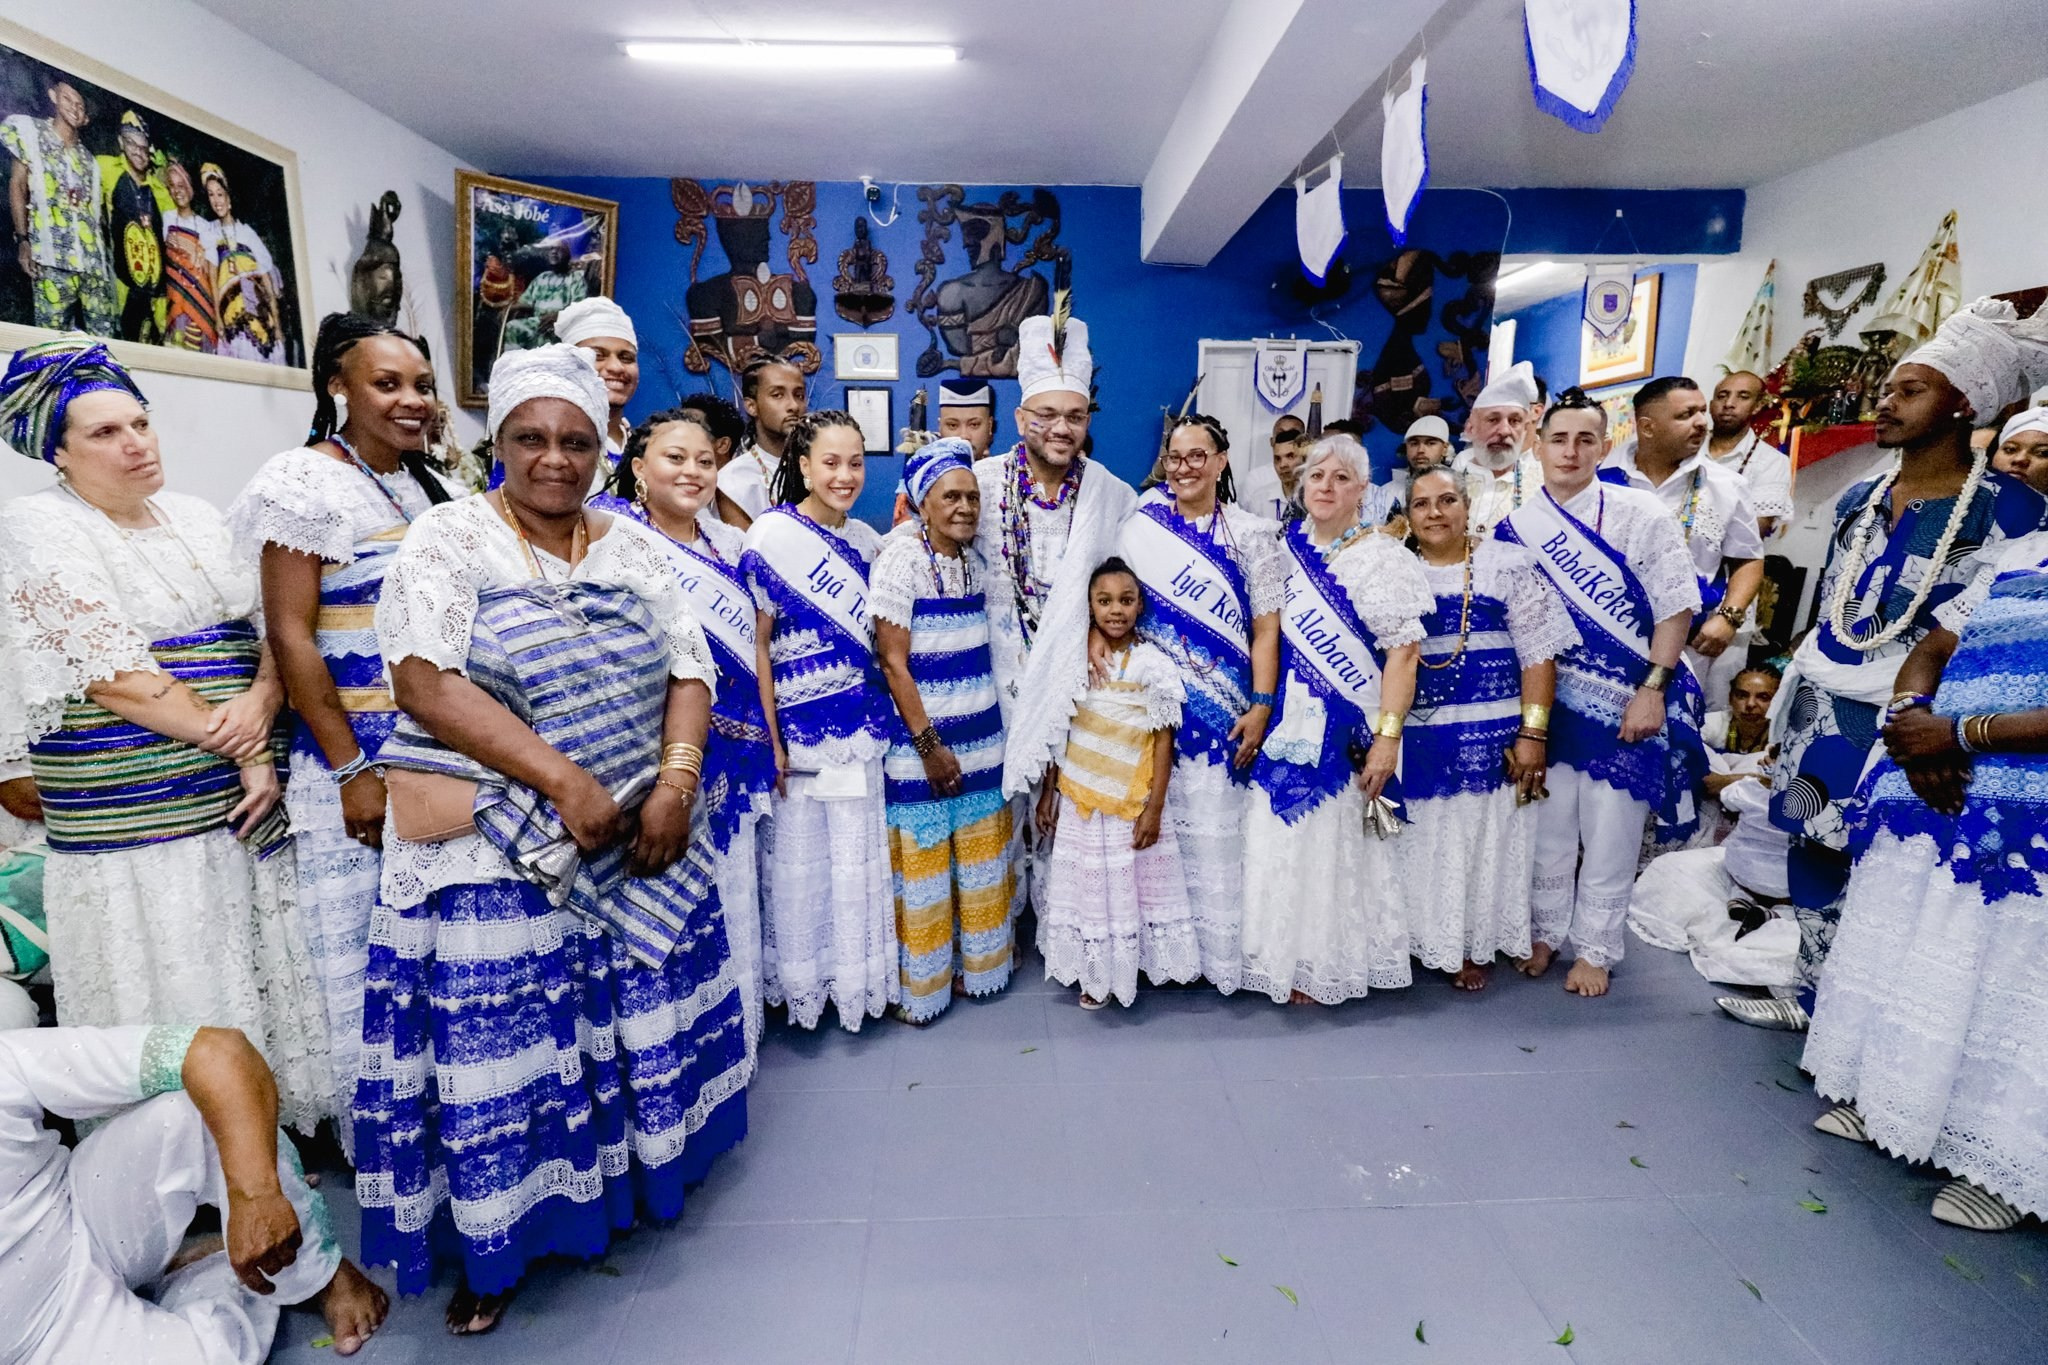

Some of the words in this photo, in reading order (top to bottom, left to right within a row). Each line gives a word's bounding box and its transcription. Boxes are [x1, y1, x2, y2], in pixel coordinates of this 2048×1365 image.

[807, 551, 847, 599] Ìyá
[1170, 559, 1211, 602] Ìyá
[1290, 607, 1373, 692] Alabawi
